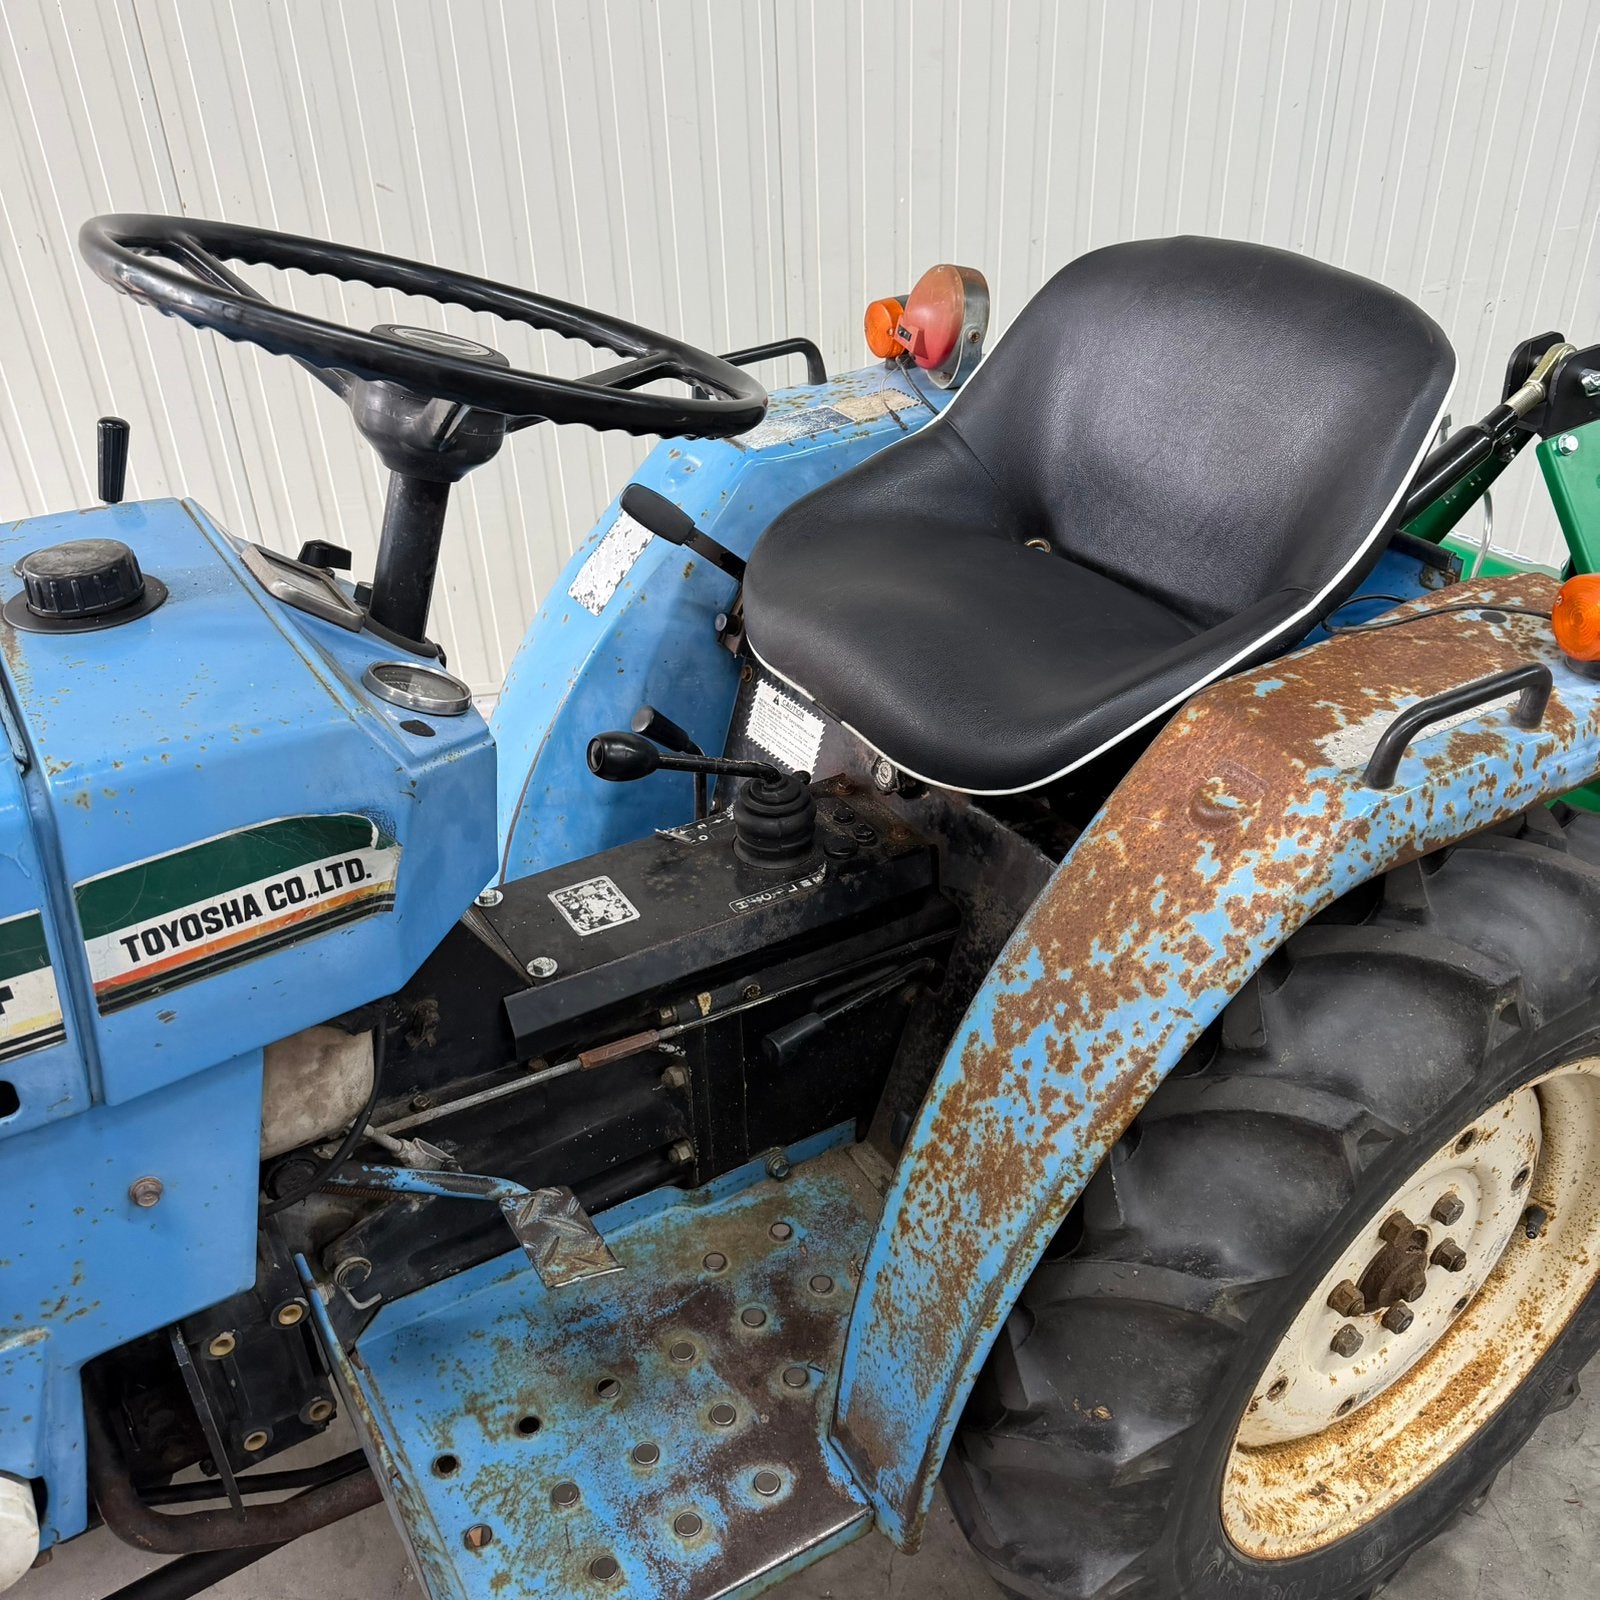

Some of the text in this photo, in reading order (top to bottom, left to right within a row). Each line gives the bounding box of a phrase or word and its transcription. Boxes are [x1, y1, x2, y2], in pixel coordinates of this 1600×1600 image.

[782, 699, 805, 718] CAUTION
[119, 857, 372, 964] TOYOSHA CO.,LTD.
